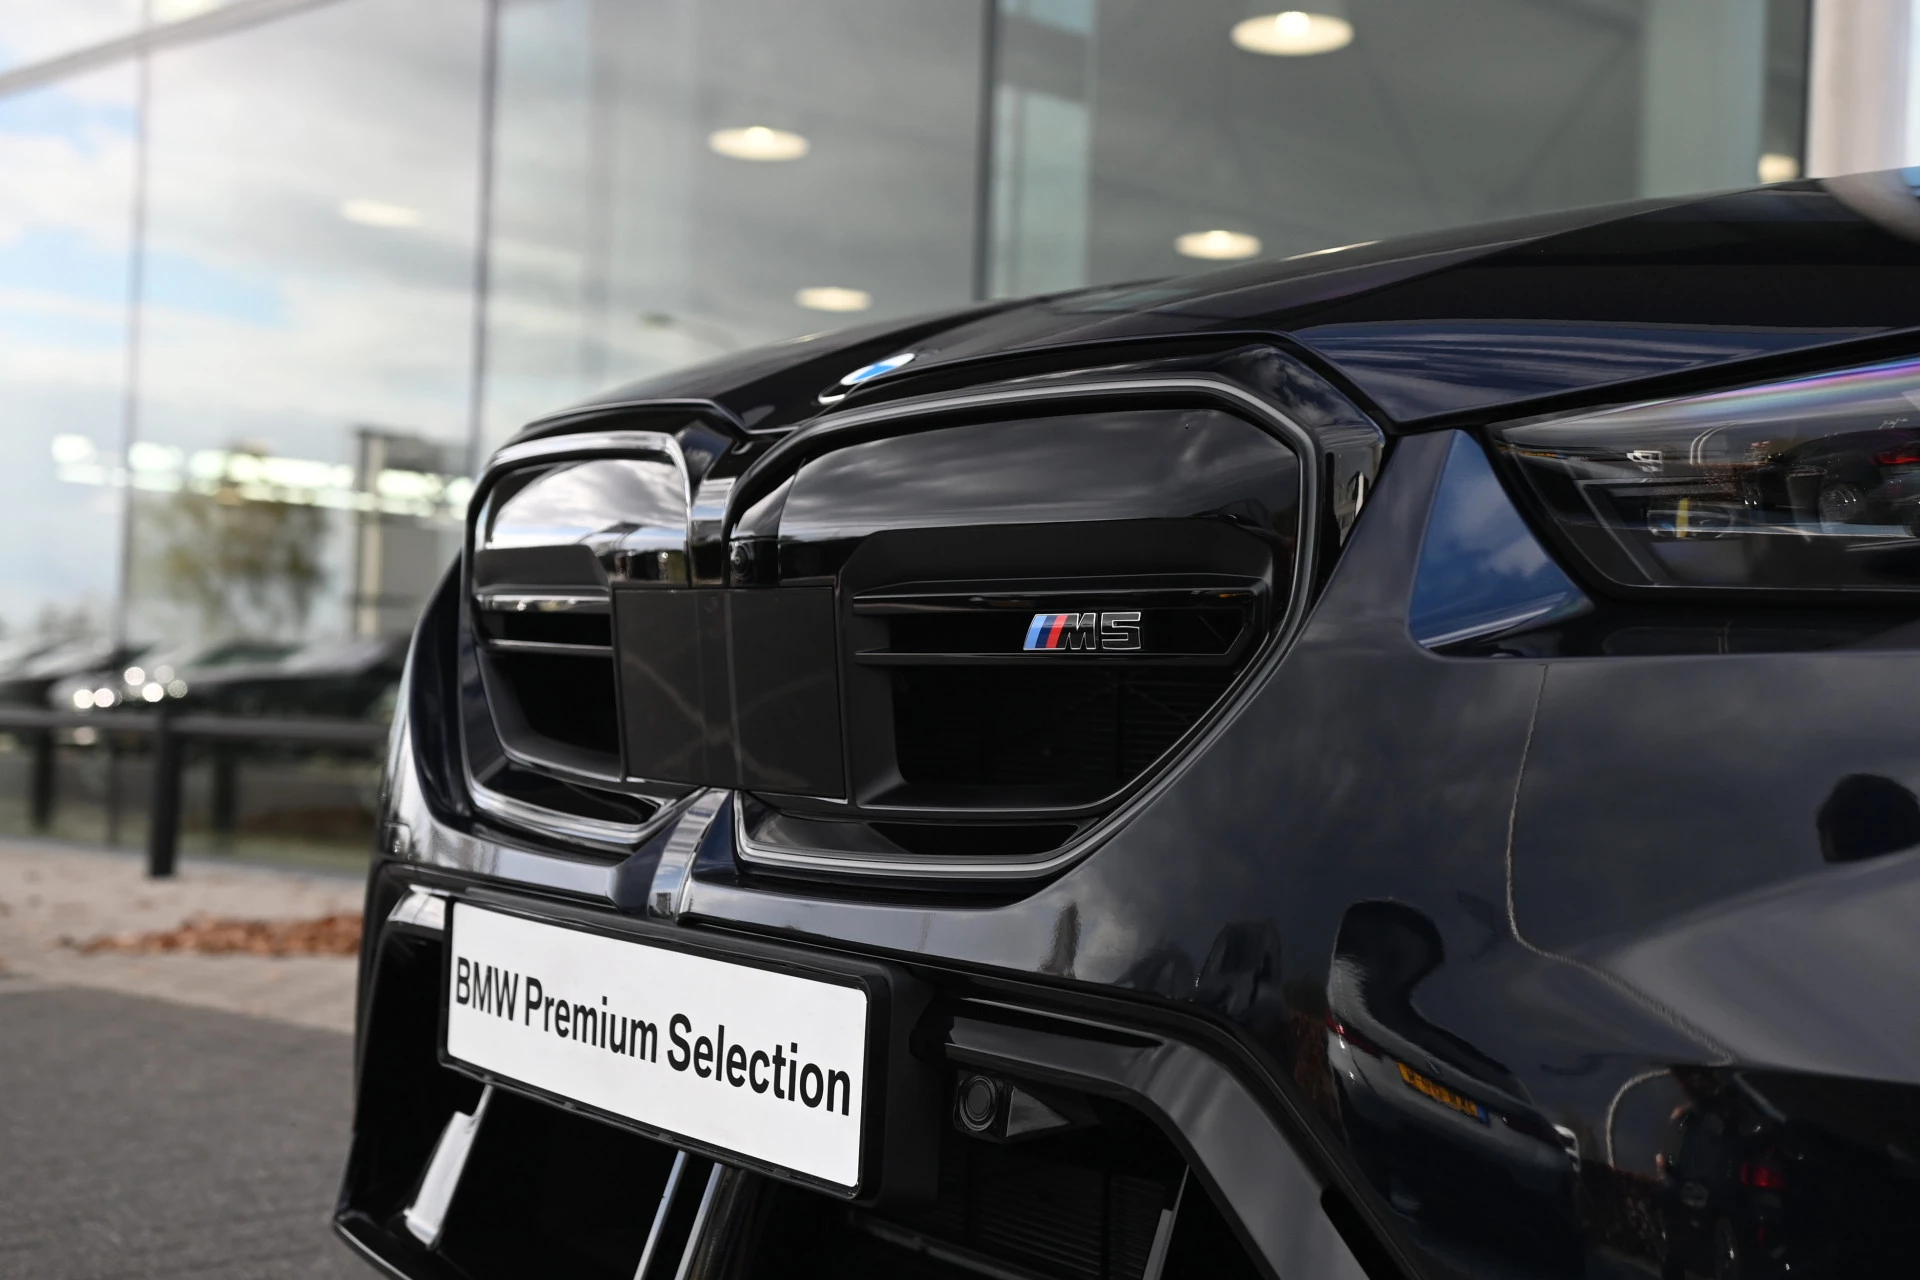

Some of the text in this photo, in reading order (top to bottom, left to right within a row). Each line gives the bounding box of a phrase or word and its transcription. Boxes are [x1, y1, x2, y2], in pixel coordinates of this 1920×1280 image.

[1054, 611, 1142, 651] M5
[455, 956, 851, 1117] BMW Premium Selection
